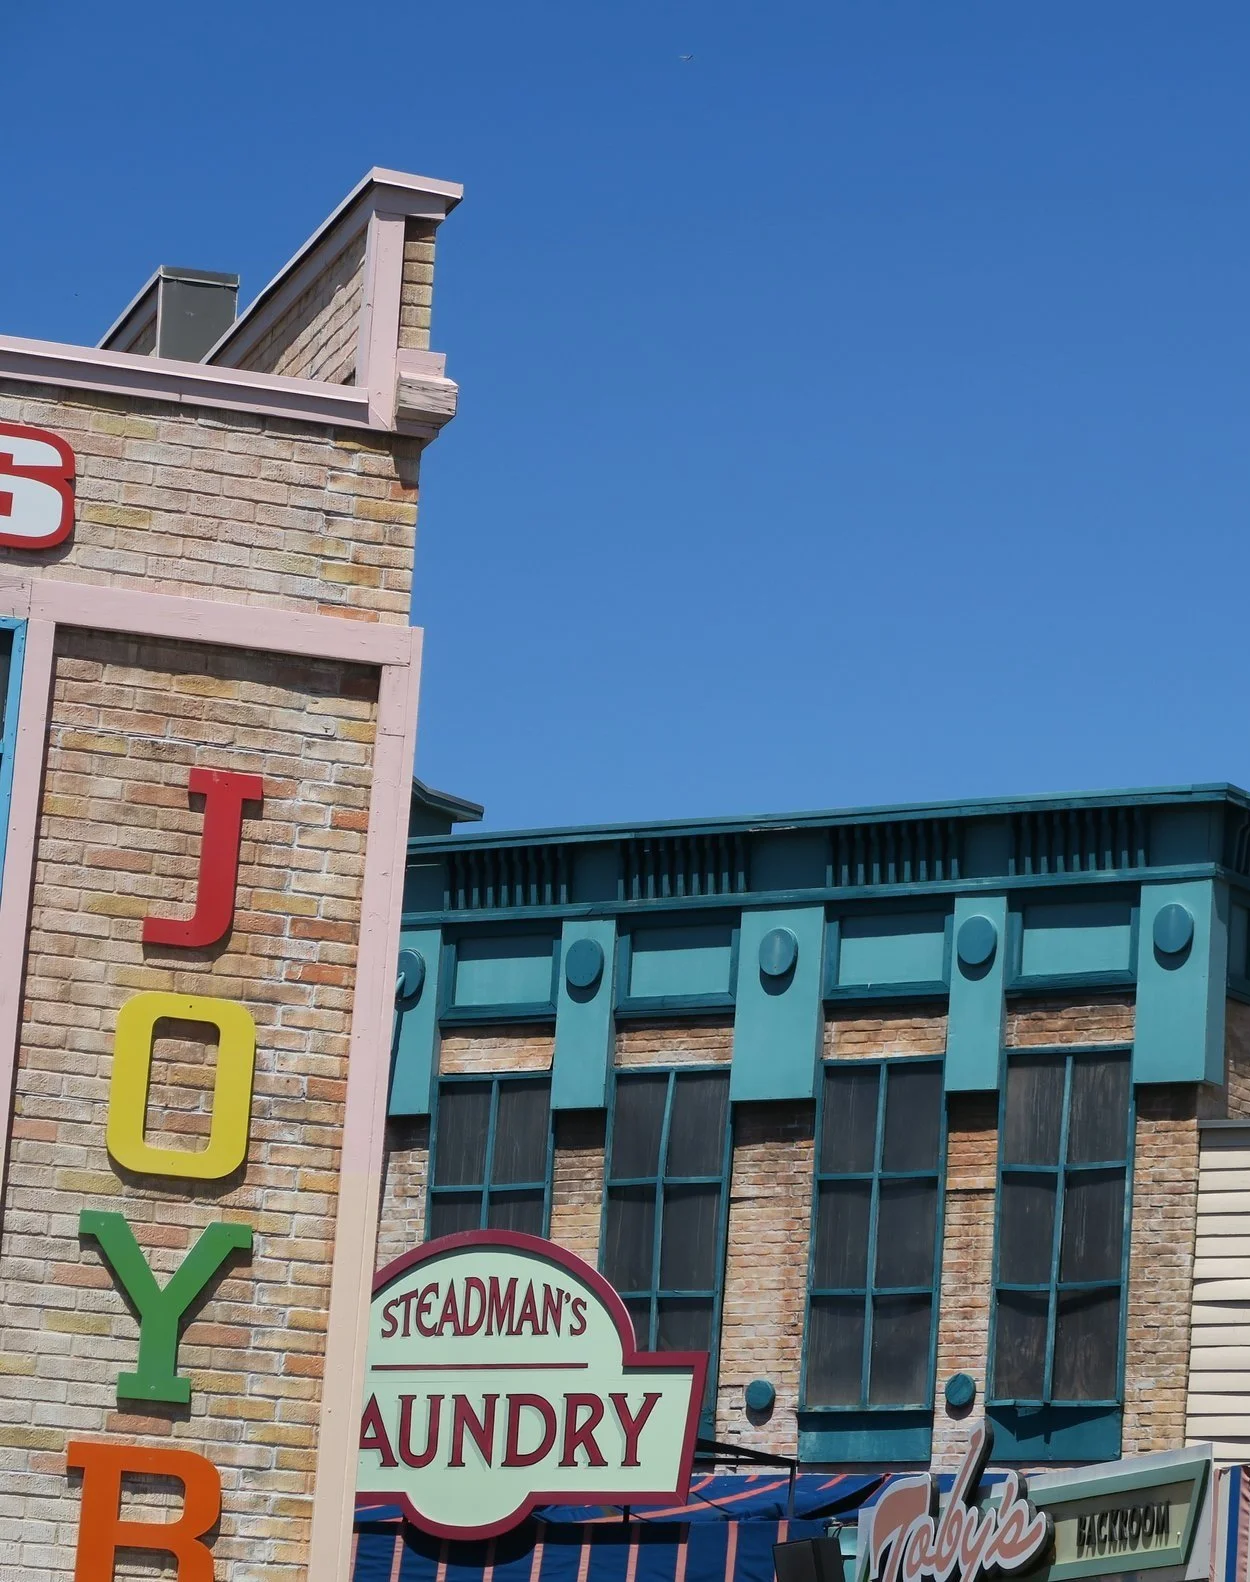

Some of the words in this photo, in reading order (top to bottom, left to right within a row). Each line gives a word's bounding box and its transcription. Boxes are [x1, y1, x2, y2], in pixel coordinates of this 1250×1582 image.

[381, 1276, 588, 1338] STEADMAN'S
[870, 1419, 1047, 1582] Toby's
[1076, 1499, 1170, 1548] BACKROOM
